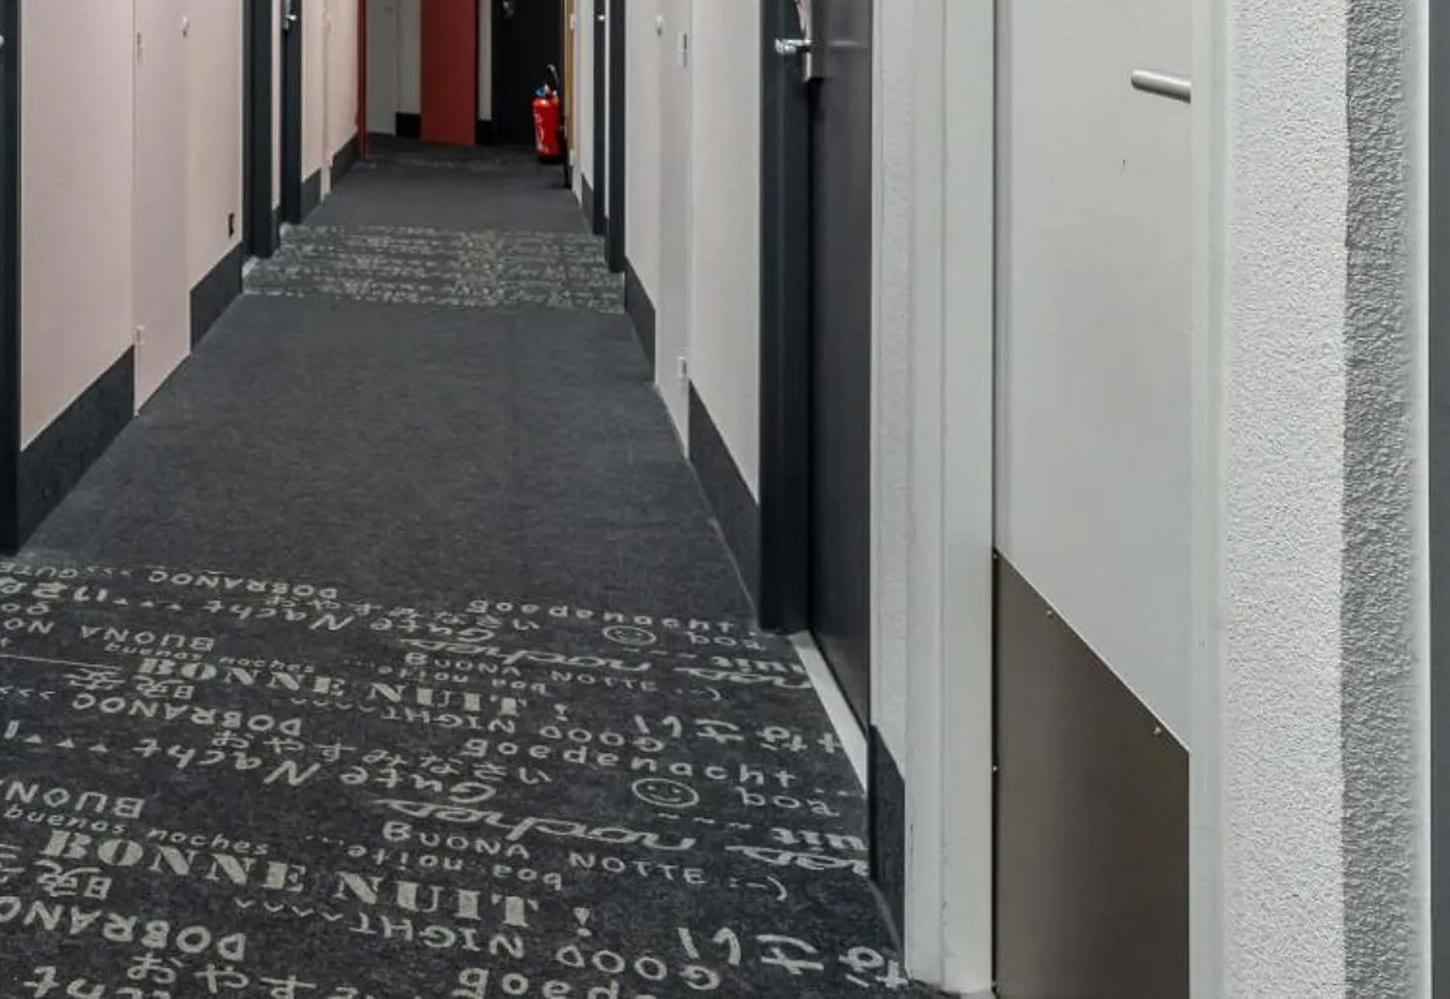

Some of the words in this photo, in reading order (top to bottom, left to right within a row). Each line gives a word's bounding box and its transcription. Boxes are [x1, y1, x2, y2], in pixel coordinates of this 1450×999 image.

[203, 600, 353, 630] Nacht
[369, 617, 495, 642] Gute
[80, 625, 215, 651] BUONA
[134, 657, 345, 696] BONNE
[71, 692, 302, 736] DOBRANOC
[381, 706, 515, 733] NIGHT
[538, 724, 665, 752] GOOD
[132, 738, 320, 785] Nacht
[339, 765, 496, 803] Gute
[36, 829, 306, 892] BONNE
[333, 871, 538, 927] NUIT
[349, 911, 524, 958] NIGHT
[555, 943, 720, 990] GOOD
